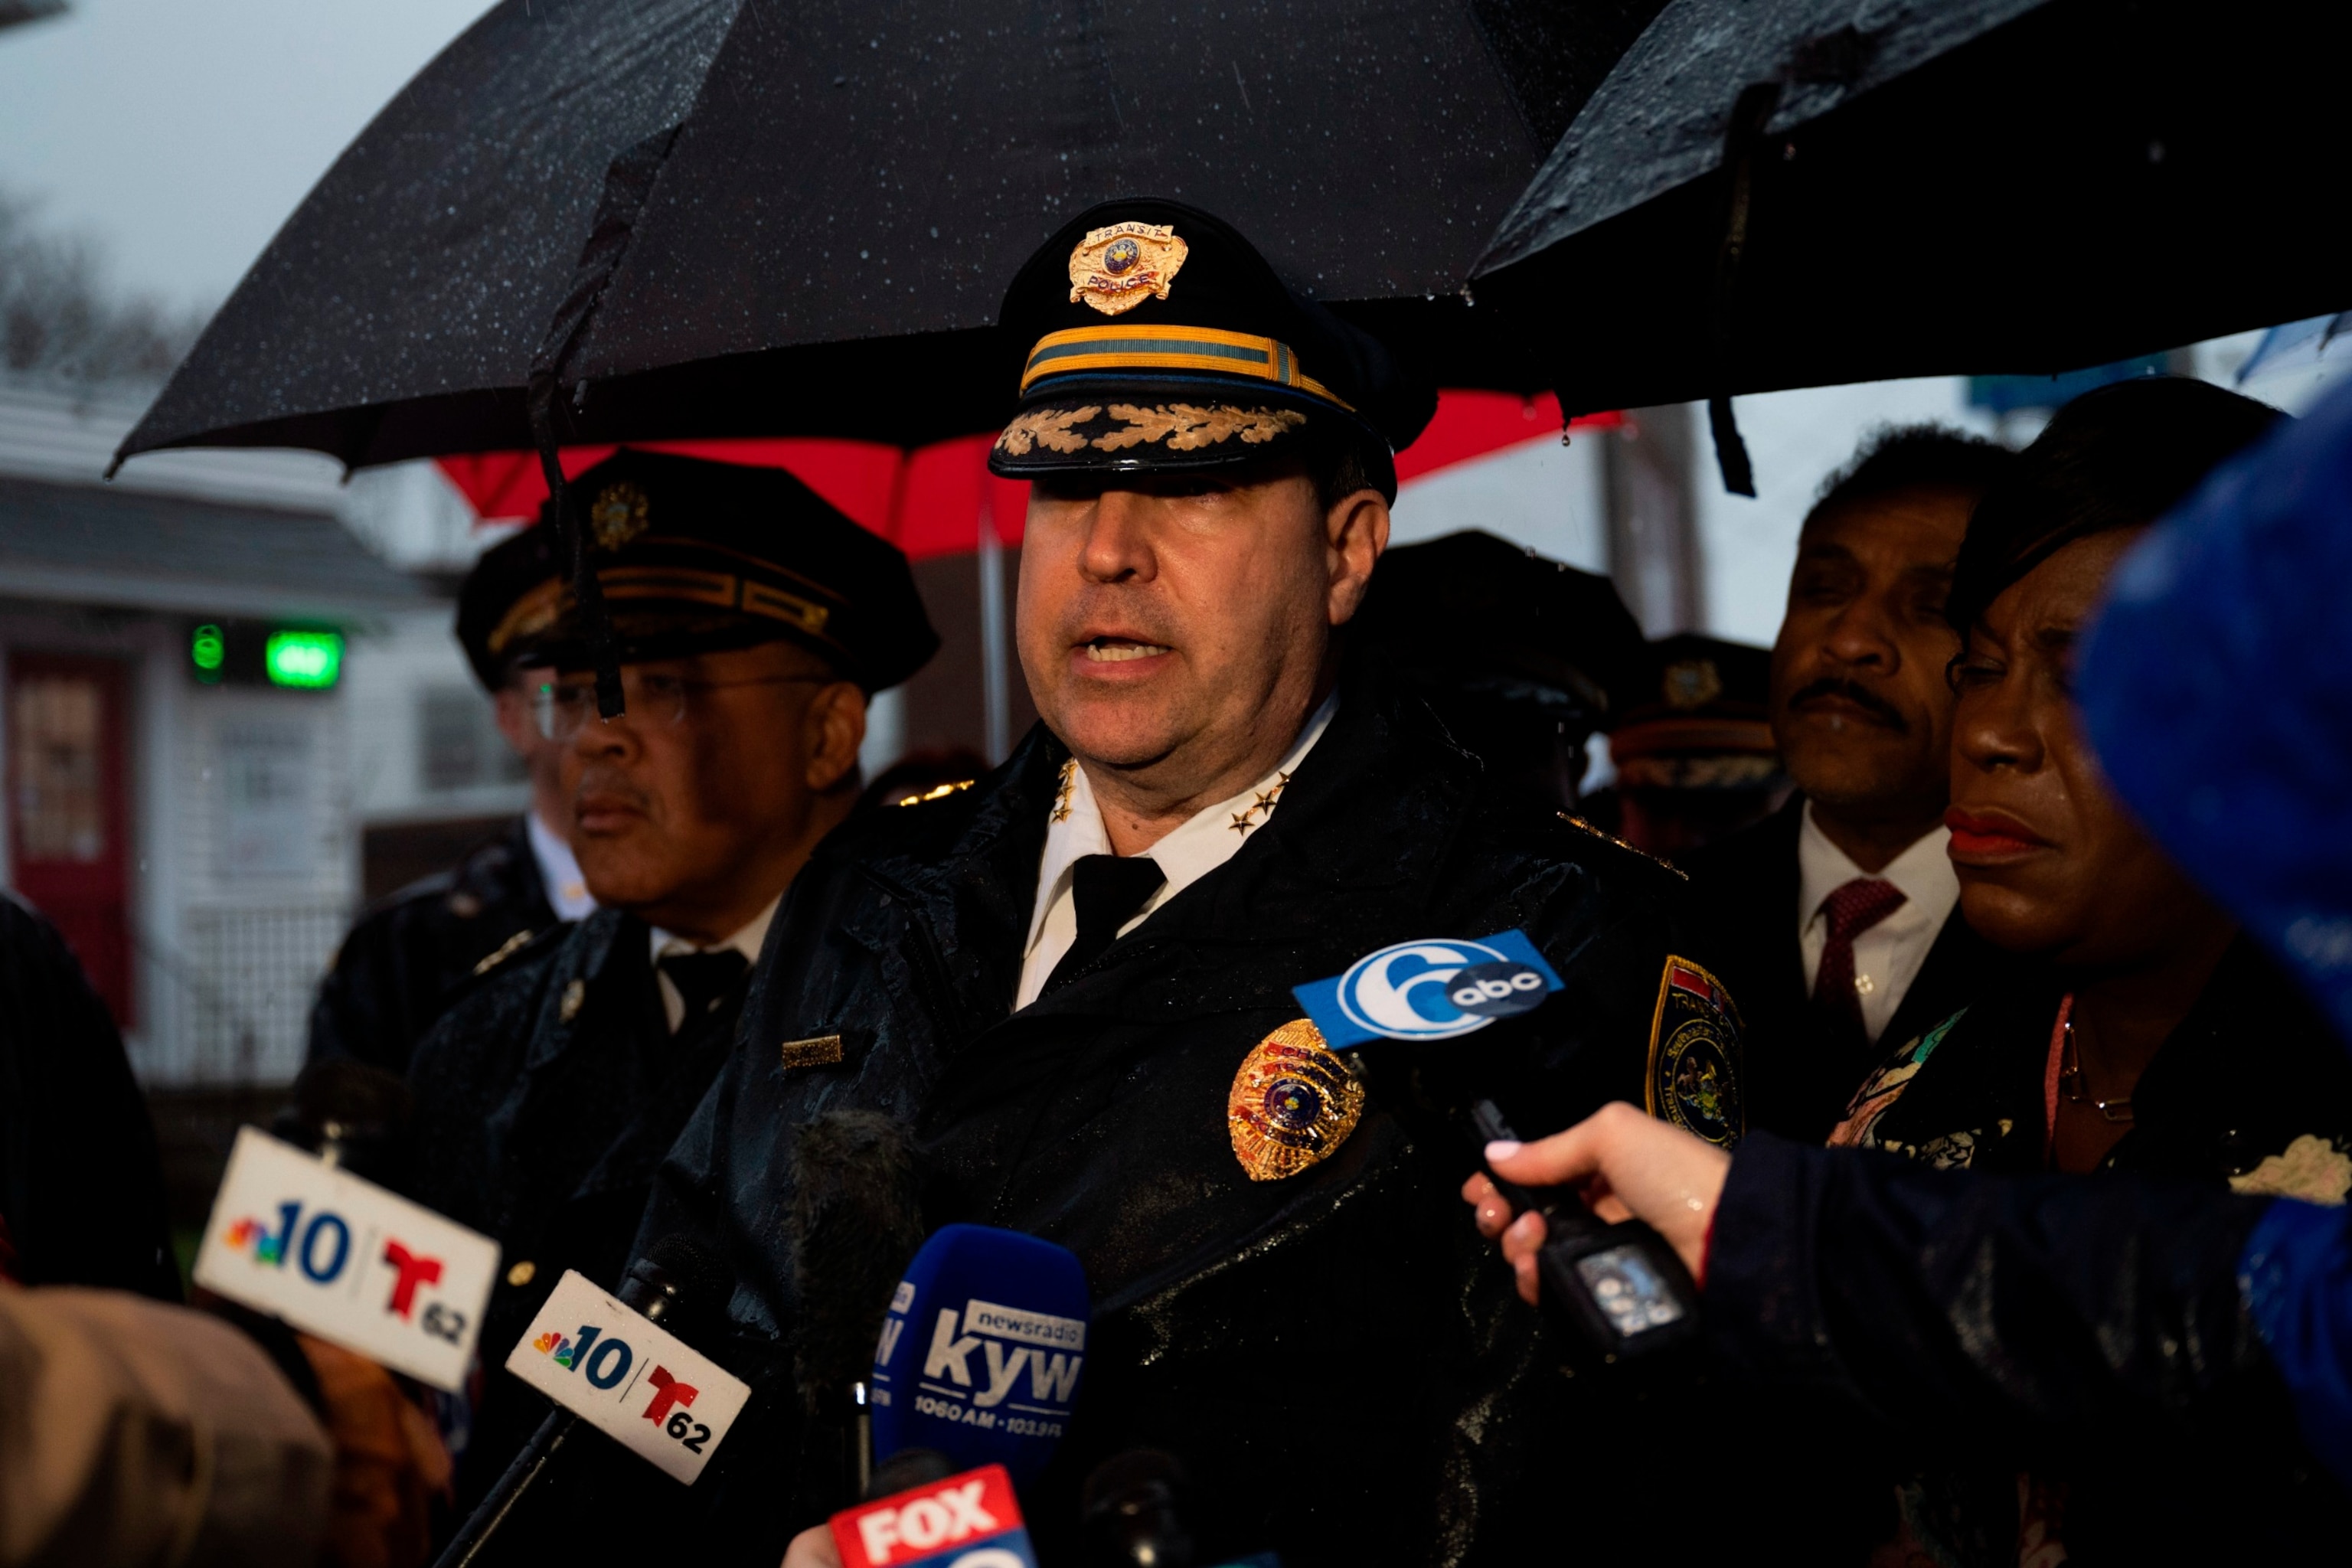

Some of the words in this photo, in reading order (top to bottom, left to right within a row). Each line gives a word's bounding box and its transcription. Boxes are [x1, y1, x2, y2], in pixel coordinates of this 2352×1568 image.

[1095, 224, 1164, 242] TRANSIT
[1088, 273, 1149, 292] POLICE
[1452, 972, 1543, 1007] abc
[276, 1199, 351, 1285] 10
[420, 1309, 468, 1347] 62
[978, 1312, 1080, 1343] newsradio
[569, 1325, 634, 1390] 10
[666, 1411, 712, 1455] 62
[858, 1479, 998, 1566] FOX
